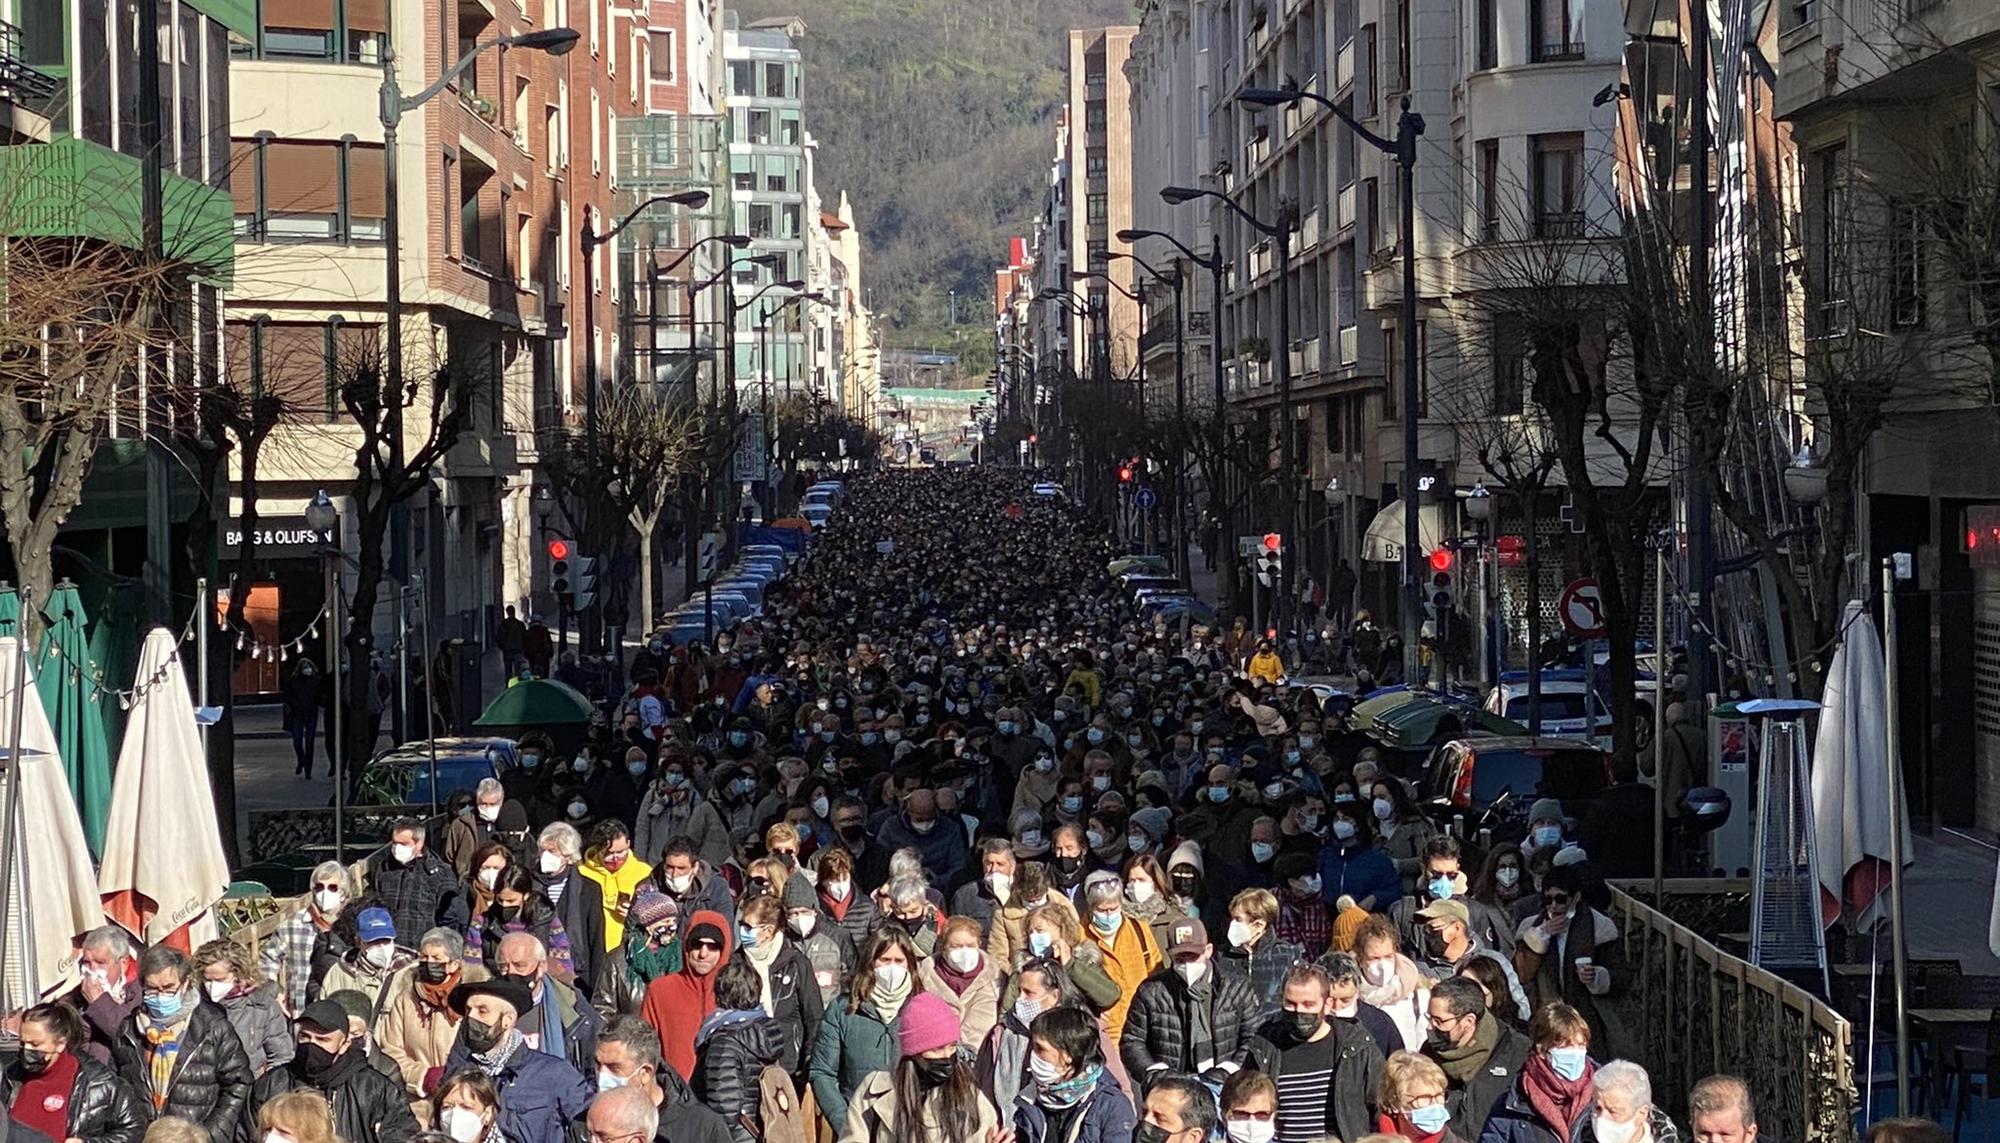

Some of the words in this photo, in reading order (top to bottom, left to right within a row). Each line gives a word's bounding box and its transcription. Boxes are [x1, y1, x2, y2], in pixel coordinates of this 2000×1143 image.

[226, 531, 262, 545] BAG
[263, 530, 274, 544] &
[275, 530, 332, 544] OLUFSN
